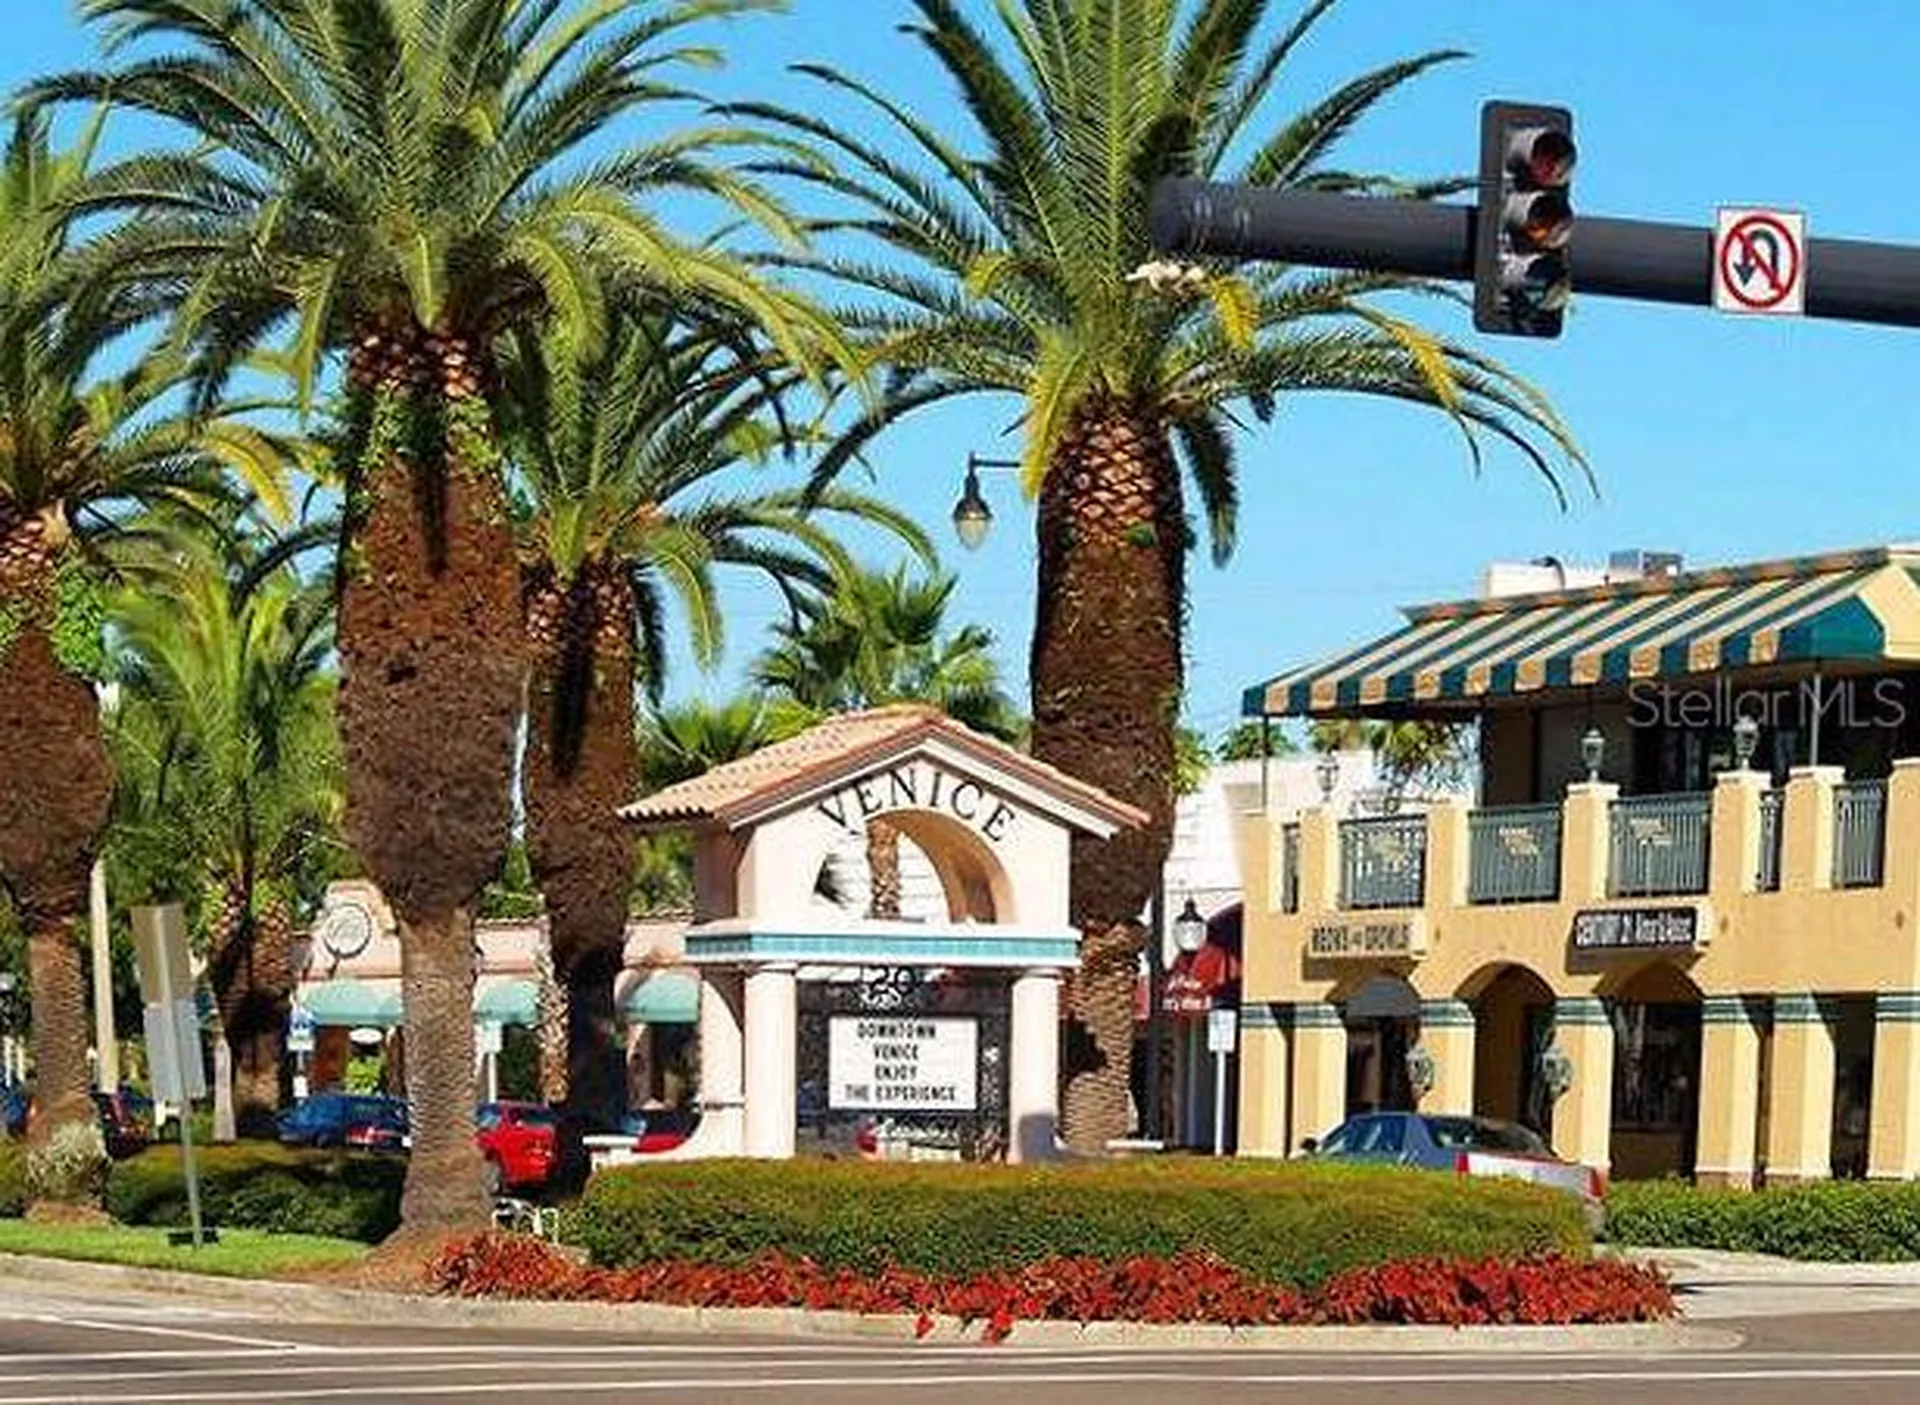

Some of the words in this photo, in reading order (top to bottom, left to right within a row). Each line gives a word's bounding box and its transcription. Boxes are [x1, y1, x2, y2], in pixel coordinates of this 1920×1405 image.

[817, 768, 1016, 842] VENICE
[856, 1022, 937, 1039] DOWNTOWN
[872, 1043, 919, 1060] VENICE
[873, 1064, 918, 1081] ENJOY
[845, 1083, 870, 1100] THE
[874, 1084, 956, 1102] EXPERIENCE
